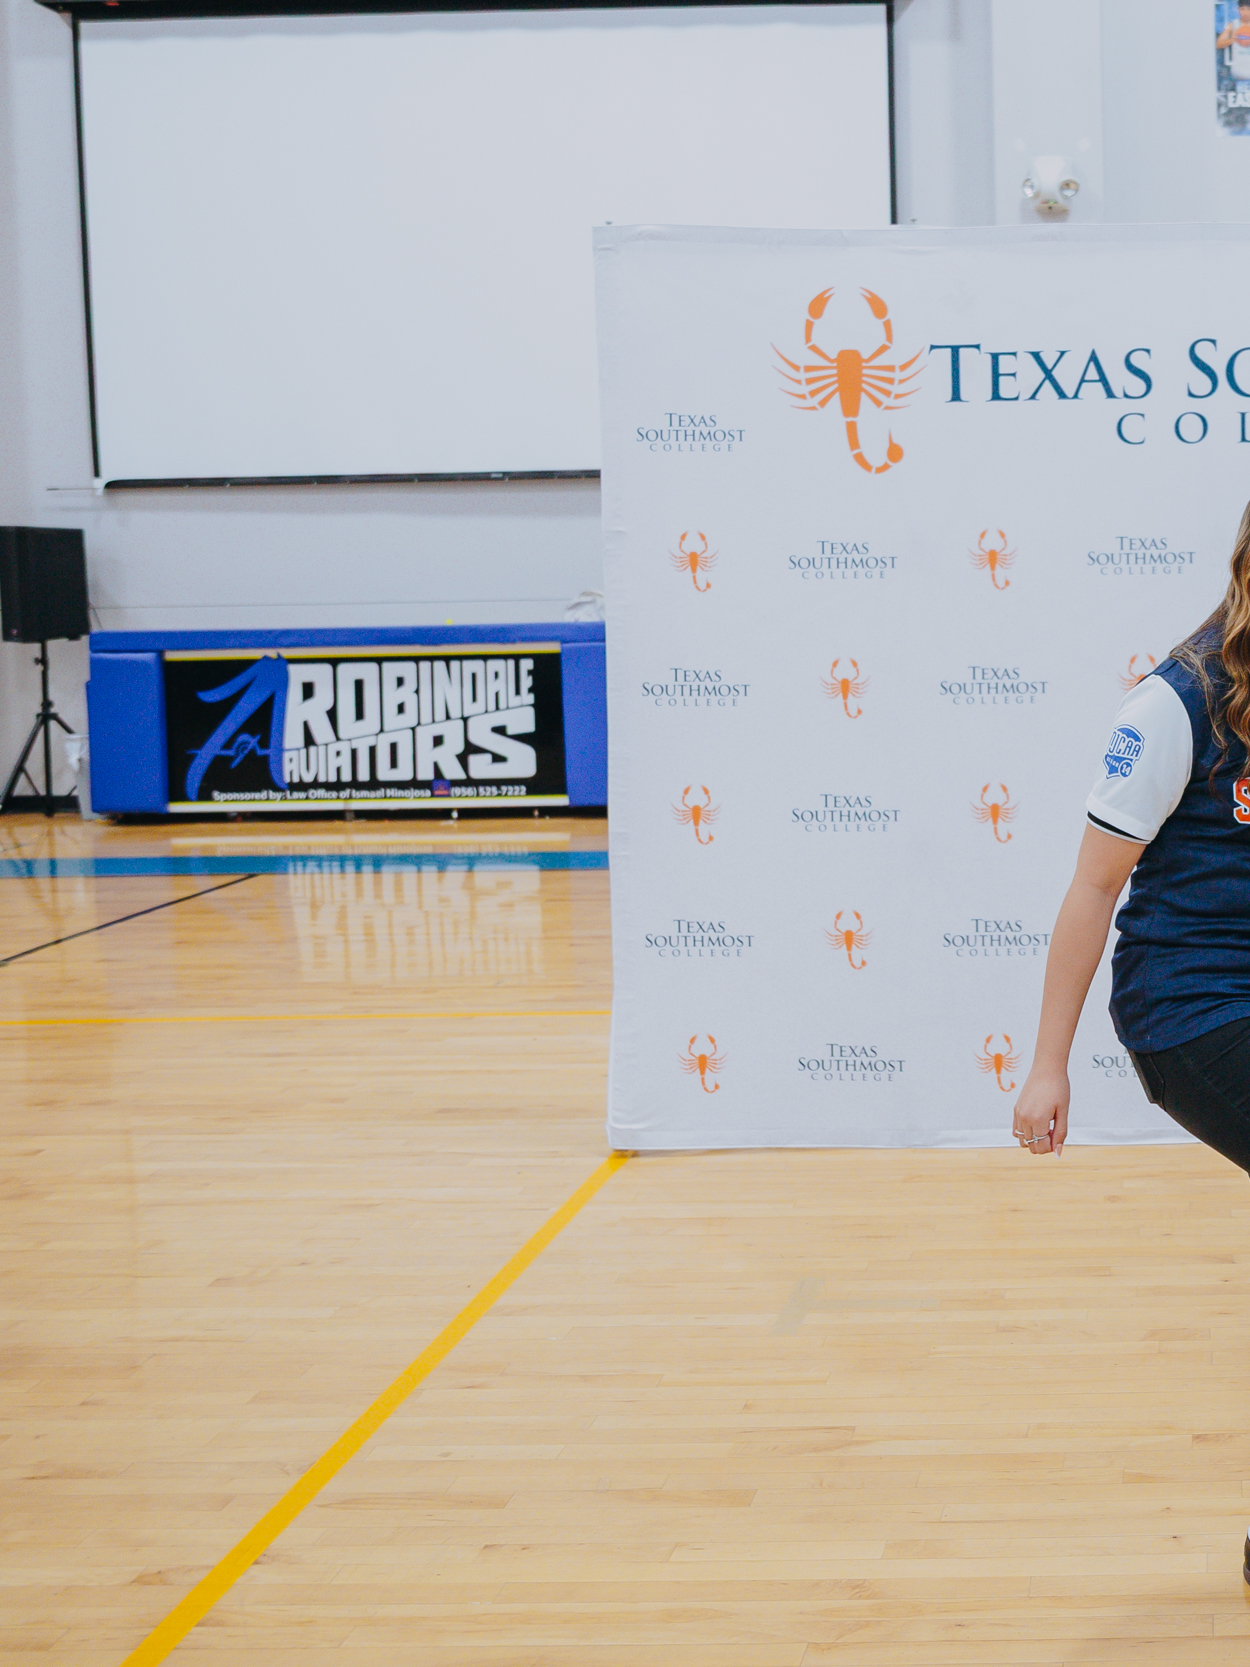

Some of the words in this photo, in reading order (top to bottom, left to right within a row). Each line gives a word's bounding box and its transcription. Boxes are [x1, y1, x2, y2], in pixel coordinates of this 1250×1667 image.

[927, 342, 1154, 404] TEXAS
[664, 412, 717, 428] TEXAS
[636, 426, 747, 443] SOUTHMOST
[649, 442, 734, 453] COLLEGE
[816, 540, 870, 555] TEXAS
[1115, 535, 1168, 551] TEXAS
[788, 554, 898, 570] SOUTHMOST
[1087, 550, 1196, 566] SOUTHMOST
[801, 570, 886, 580] COLLEGE
[1100, 565, 1184, 576] COLLEGE
[669, 667, 722, 683] TEXAS
[968, 665, 1020, 681] TEXAS
[641, 681, 751, 697] SOUTHMOST
[939, 680, 1048, 696] SOUTHMOST
[284, 657, 536, 749] ROBINDALE
[654, 697, 739, 708] COLLEGE
[952, 695, 1037, 705] COLLEGE
[283, 705, 538, 784] AVIATORS
[1108, 731, 1142, 758] JCAA
[1121, 763, 1132, 776] 14
[211, 790, 268, 802] Sponsored
[286, 790, 308, 800] Law
[308, 788, 338, 799] Office
[352, 788, 385, 799] Ismael
[386, 787, 432, 800] Hinojosa
[450, 785, 477, 798] (956)
[820, 793, 873, 809] TEXAS
[791, 808, 901, 823] SOUTHMOST
[804, 823, 889, 833] COLLEGE
[672, 919, 726, 934] TEXAS
[970, 918, 1023, 933] TEXAS
[645, 933, 755, 949] SOUTHMOST
[942, 932, 1051, 948] SOUTHMOST
[658, 948, 743, 958] COLLEGE
[955, 947, 1039, 957] COLLEGE
[825, 1043, 878, 1058] TEXAS
[797, 1056, 906, 1073] SOUTHMOST
[810, 1072, 895, 1082] COLLEGE
